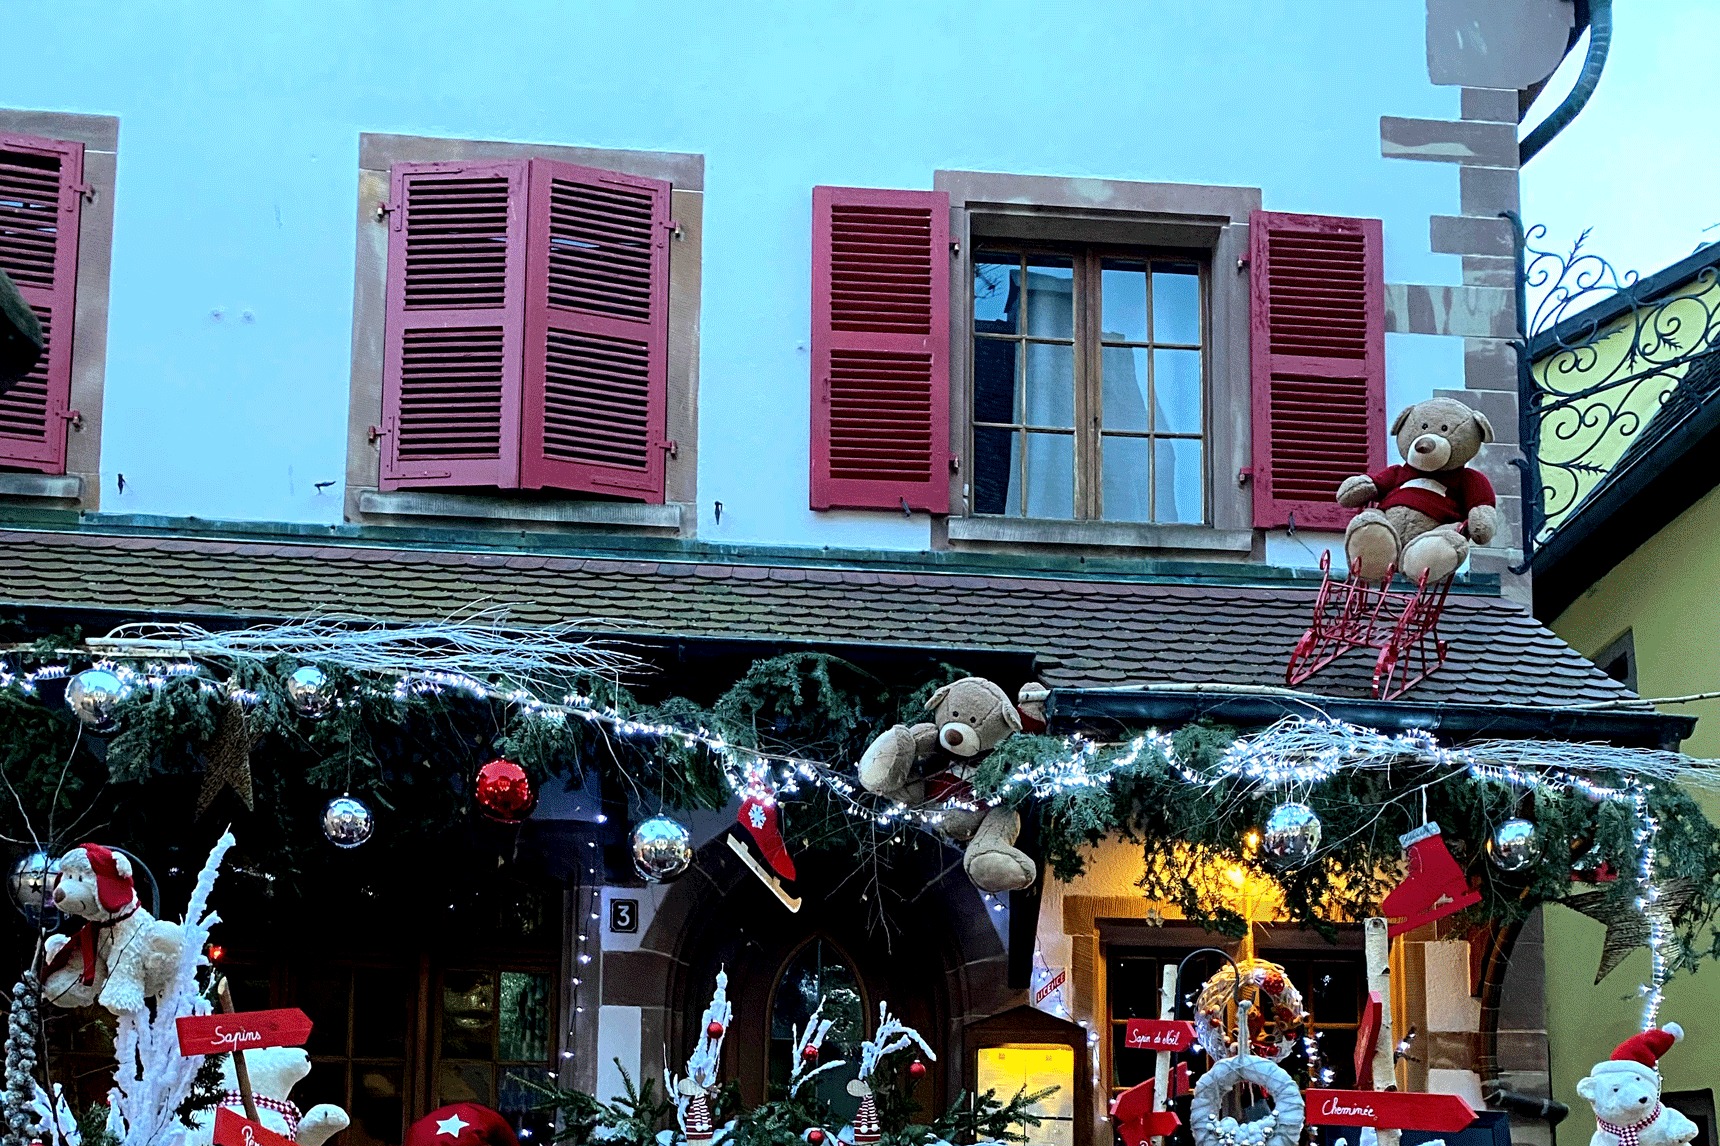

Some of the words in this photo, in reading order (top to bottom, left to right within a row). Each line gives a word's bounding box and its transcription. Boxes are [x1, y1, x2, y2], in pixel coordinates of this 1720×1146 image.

[616, 905, 630, 927] 3
[1037, 972, 1065, 1002] LICENCE
[210, 1026, 262, 1051] Sapins
[1128, 1028, 1151, 1048] Sapin
[1321, 1096, 1376, 1117] Cheminée
